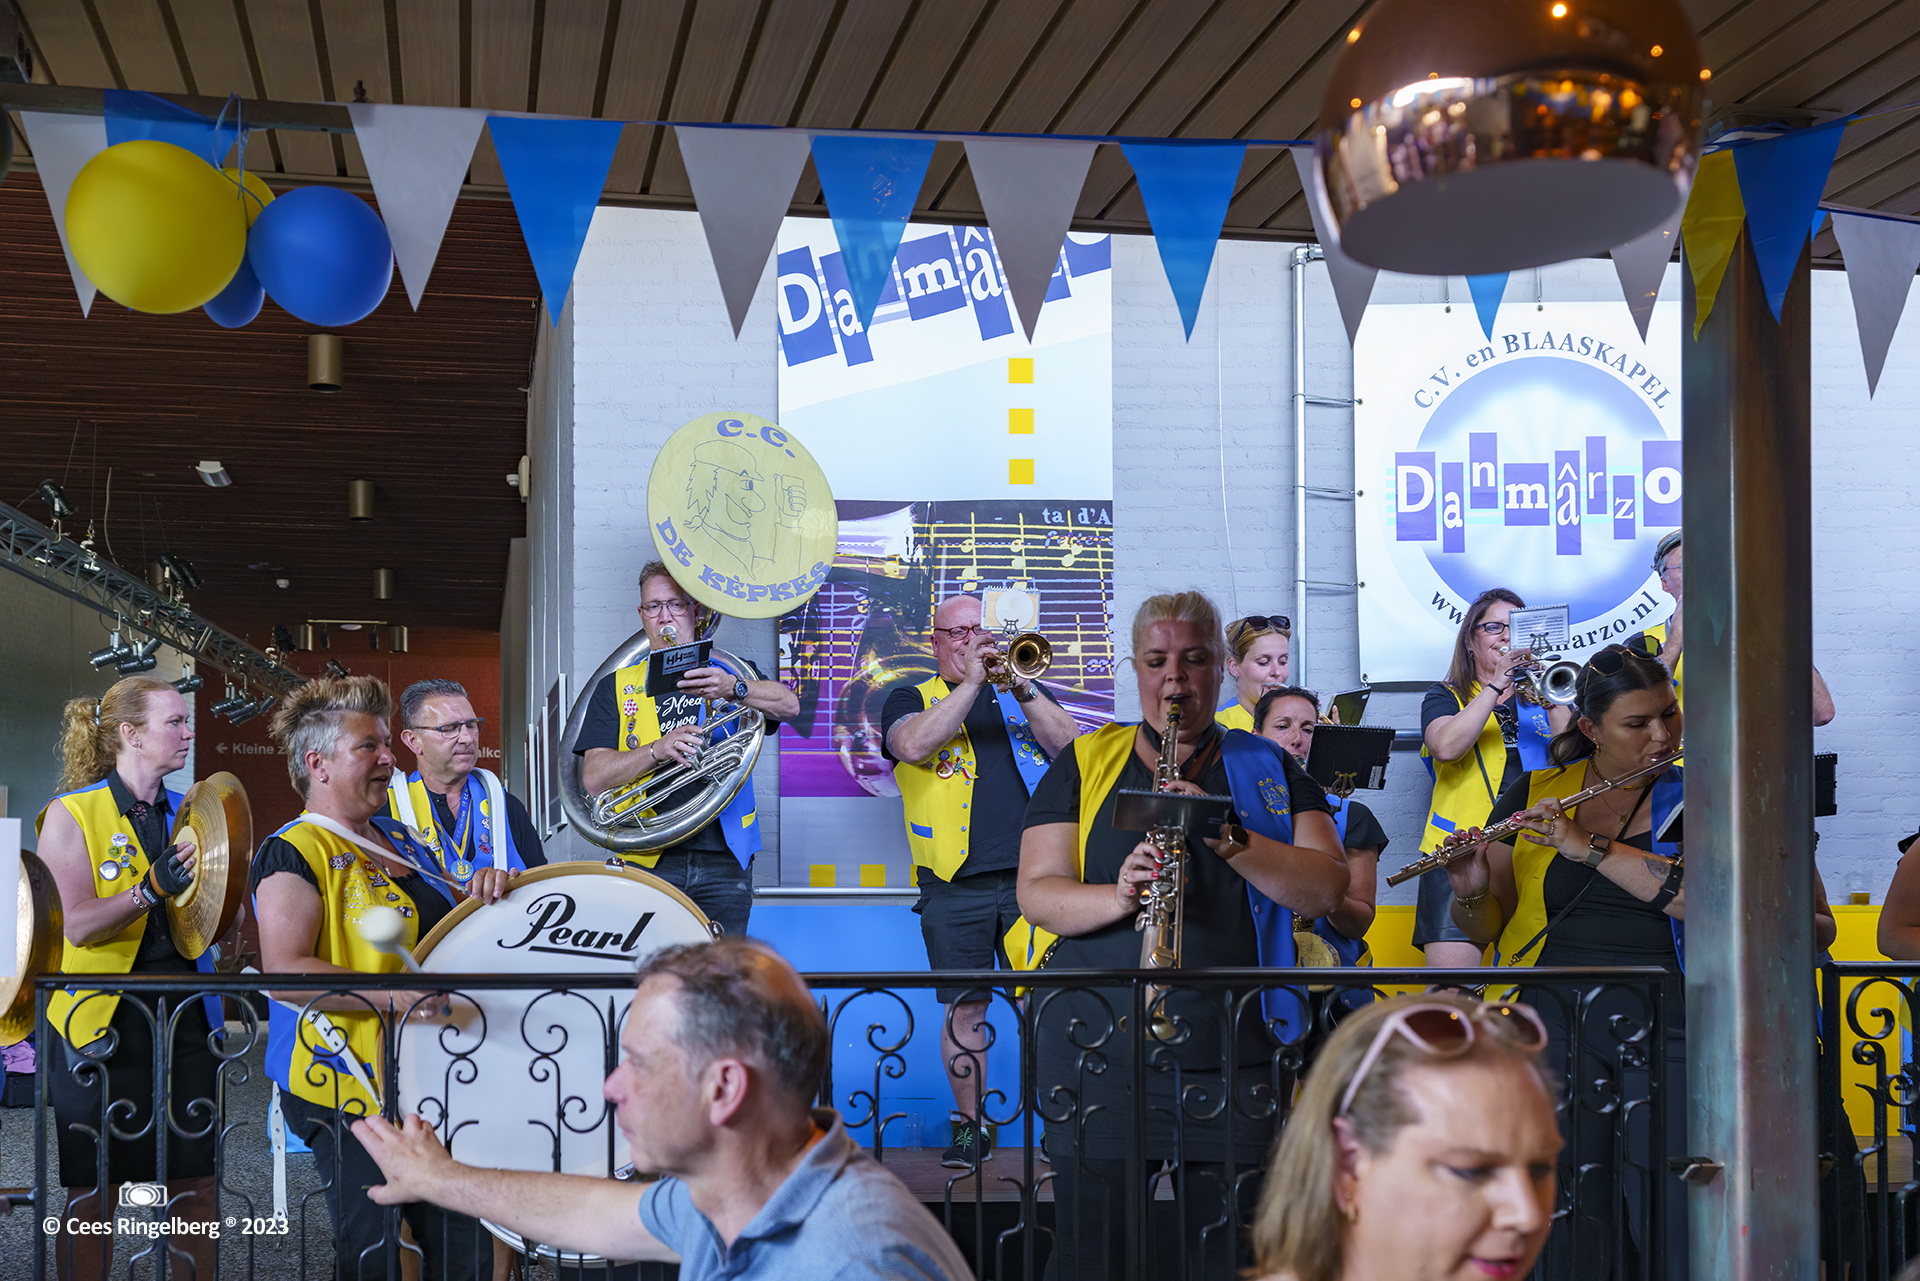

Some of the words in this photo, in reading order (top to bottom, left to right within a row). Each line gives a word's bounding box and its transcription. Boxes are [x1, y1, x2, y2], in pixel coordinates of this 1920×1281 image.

[1414, 366, 1461, 409] C.V.
[1466, 341, 1496, 368] en
[1501, 331, 1671, 410] BLAASKAPEL
[1042, 508, 1065, 524] ta
[1396, 461, 1682, 529] Danmârzo
[656, 516, 695, 567] DE
[232, 743, 274, 755] Kleine
[497, 893, 656, 952] Pearl
